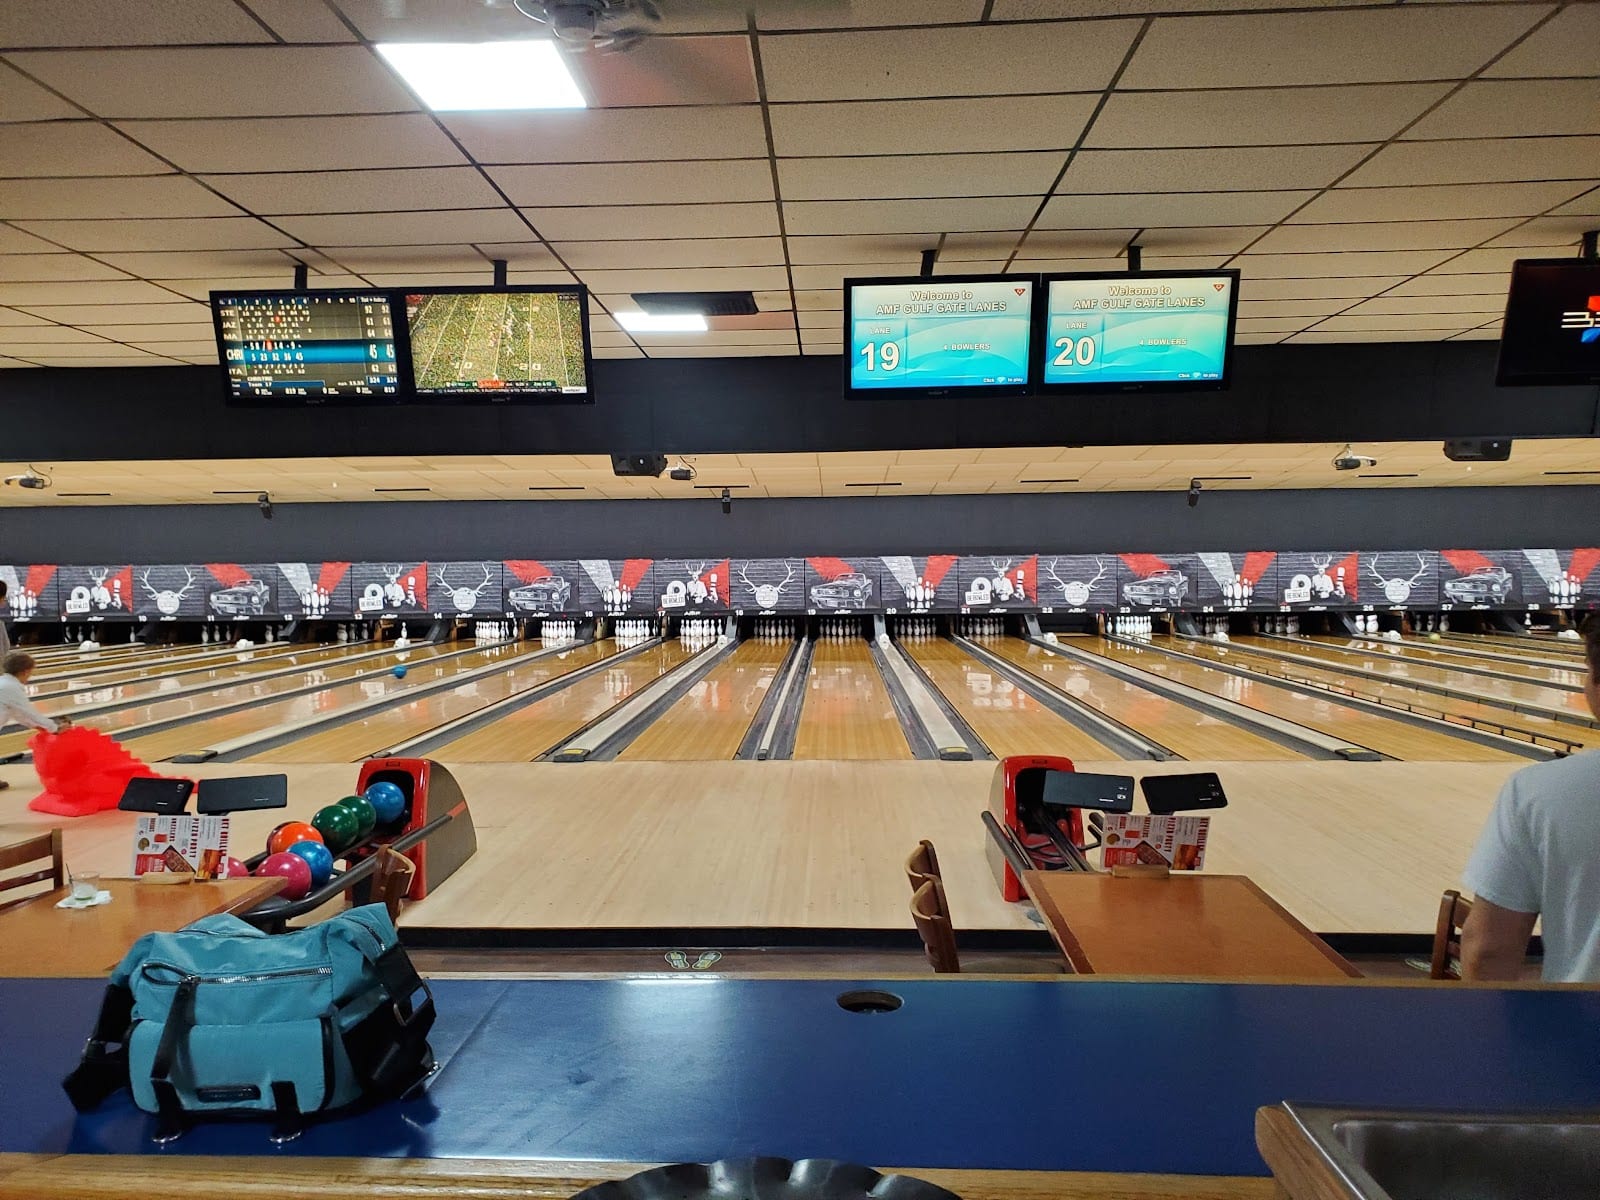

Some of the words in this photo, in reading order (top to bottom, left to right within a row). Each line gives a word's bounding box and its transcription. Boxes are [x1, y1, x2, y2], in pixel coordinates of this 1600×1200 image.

[1108, 285, 1158, 296] Welcome
[1160, 284, 1171, 295] to
[910, 290, 959, 301] Welcome
[961, 289, 973, 299] to
[1073, 299, 1098, 309] AMF
[1101, 299, 1132, 308] GULF
[1134, 298, 1164, 307] GATE
[1166, 297, 1206, 307] LANES
[875, 304, 900, 315] AMF
[903, 303, 934, 314] GULF
[936, 302, 967, 313] GATE
[969, 301, 1007, 312] LANES
[1066, 322, 1088, 330] LANE
[870, 327, 891, 335] LANE
[1148, 338, 1187, 346] BOWLERS
[951, 343, 991, 351] BOWLERS
[1053, 336, 1096, 367] 20
[860, 341, 901, 372] 19
[207, 614, 215, 622] 11
[505, 611, 515, 619] 15
[585, 610, 594, 618] 16
